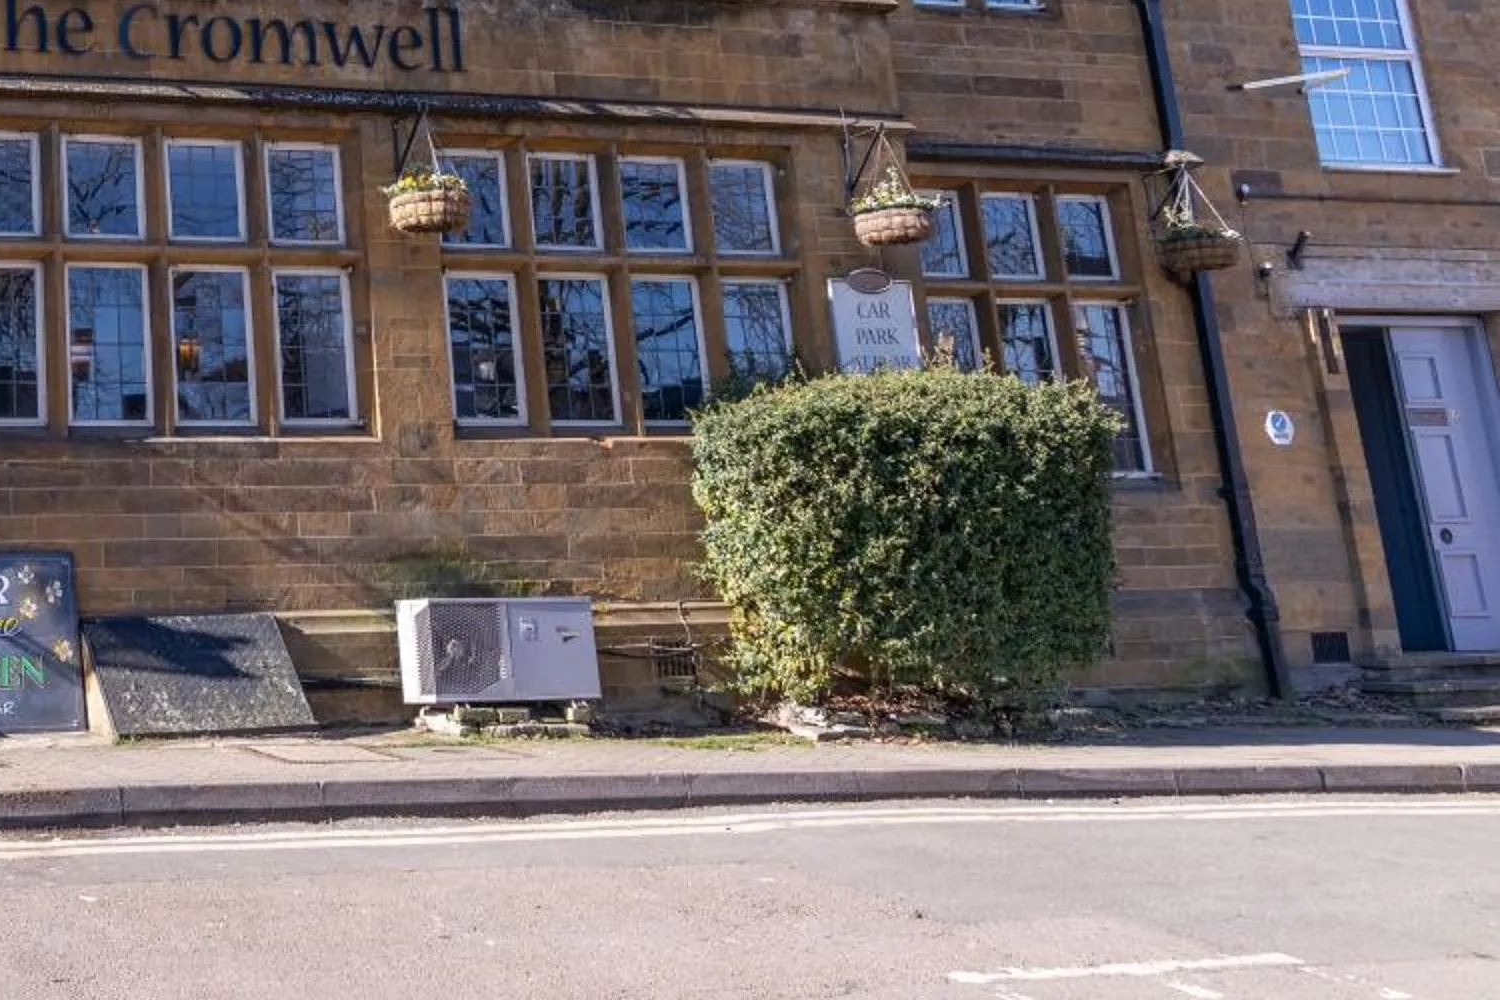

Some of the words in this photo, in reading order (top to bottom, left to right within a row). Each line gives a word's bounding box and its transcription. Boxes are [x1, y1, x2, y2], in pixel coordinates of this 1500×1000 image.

[118, 3, 469, 74] Cromwell
[856, 302, 891, 319] CAR
[855, 327, 900, 345] PARK
